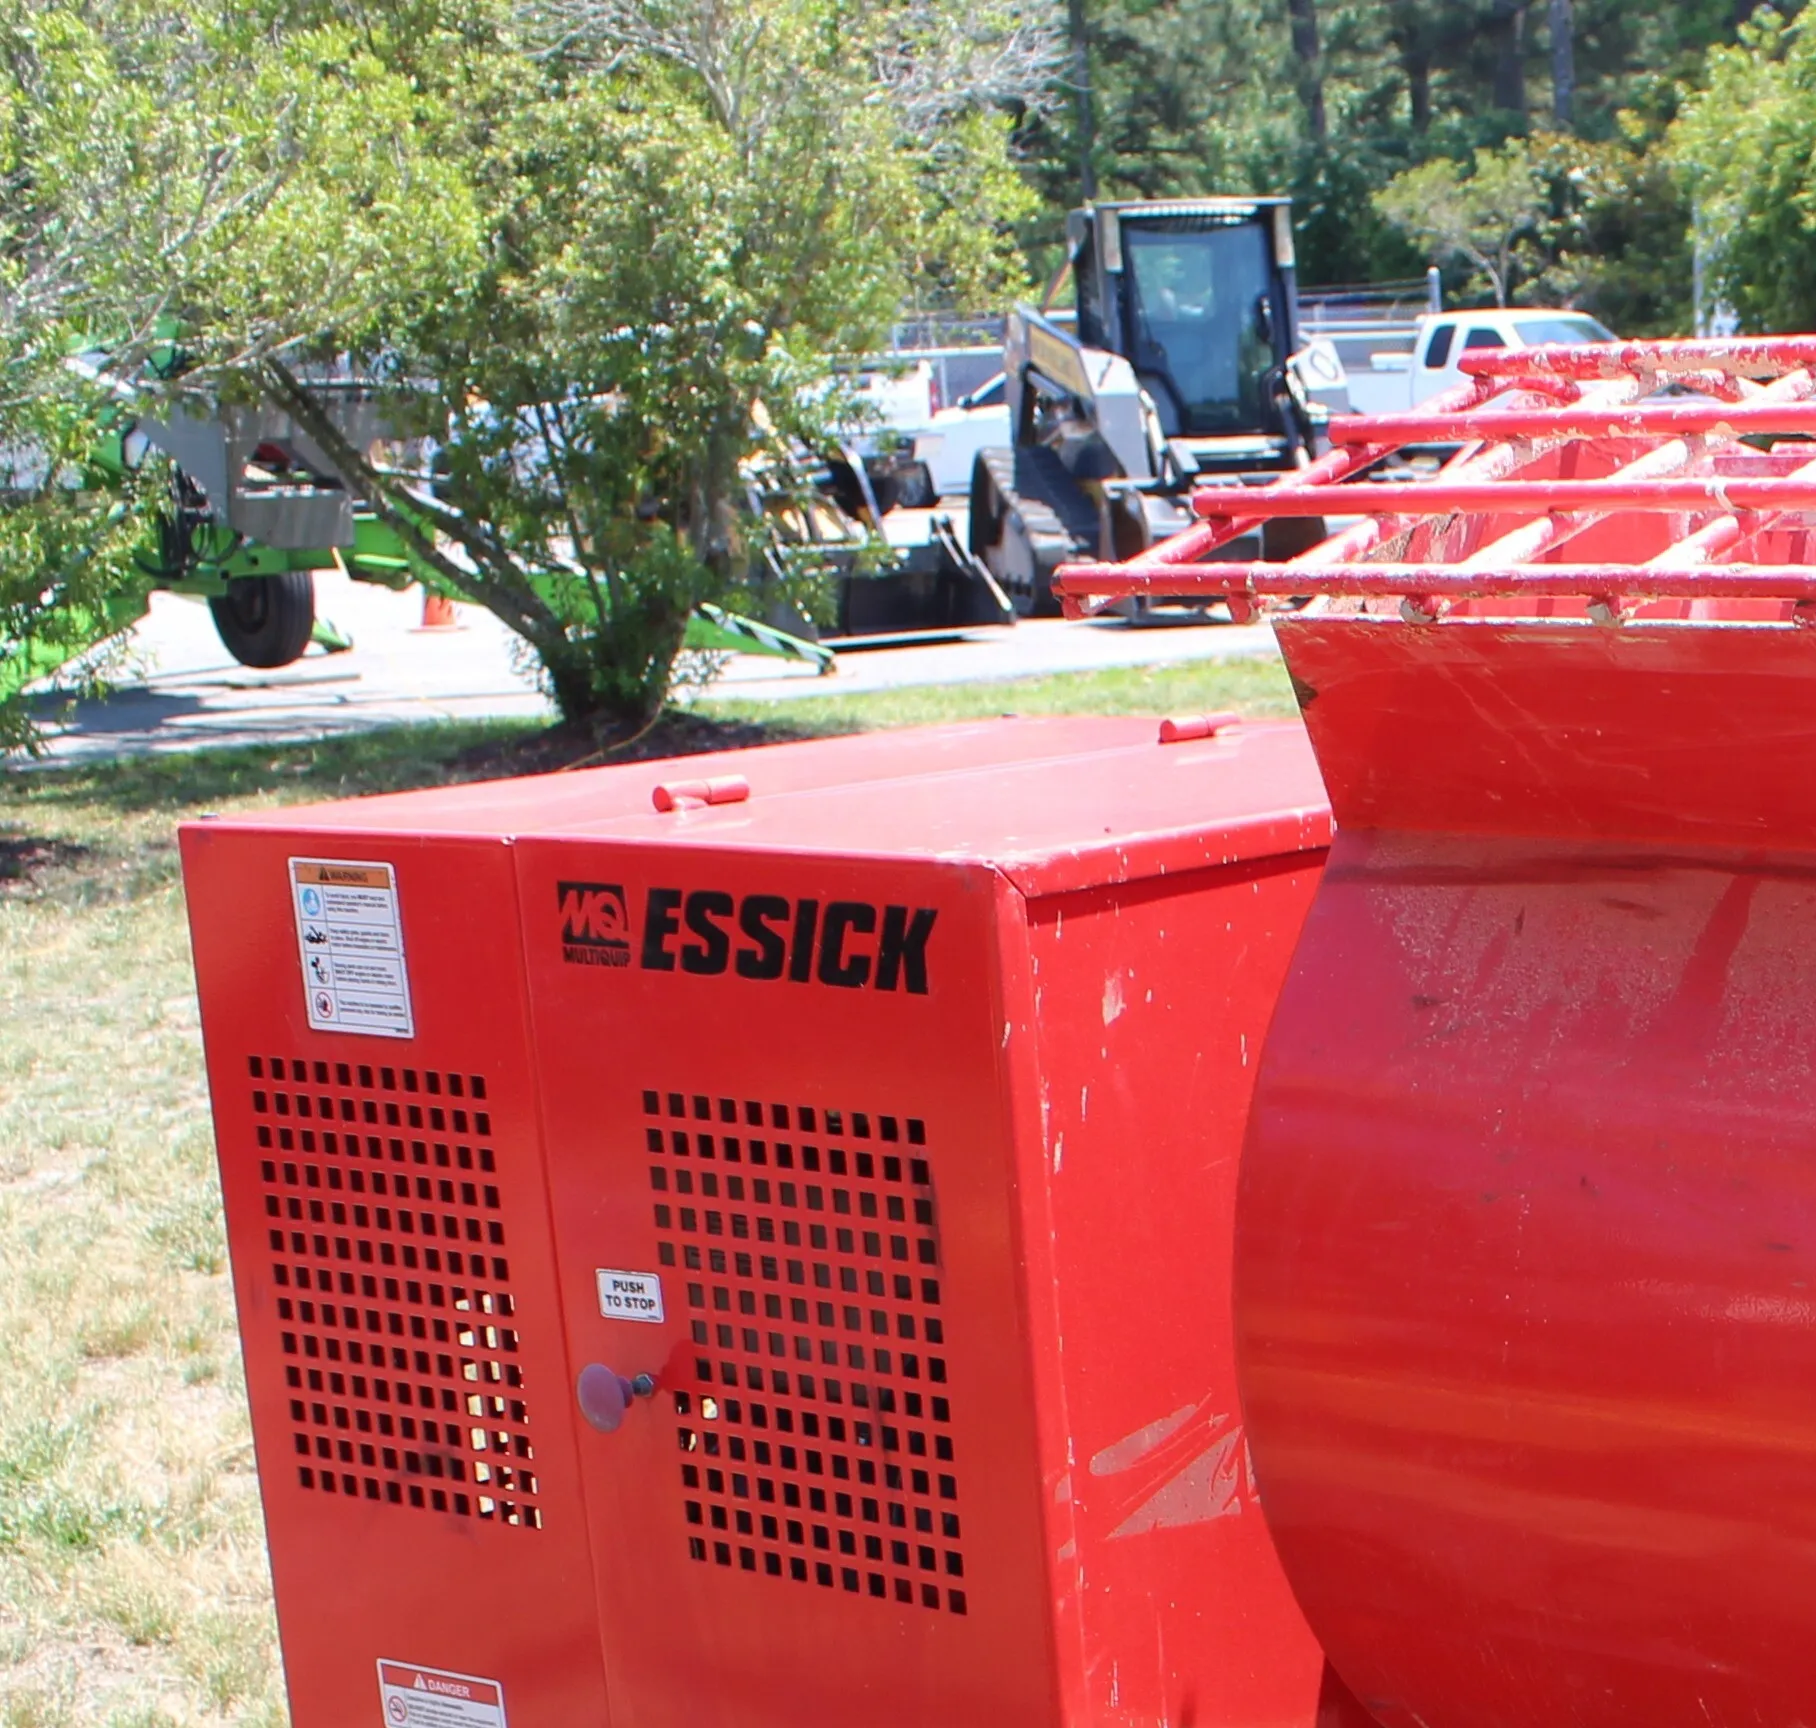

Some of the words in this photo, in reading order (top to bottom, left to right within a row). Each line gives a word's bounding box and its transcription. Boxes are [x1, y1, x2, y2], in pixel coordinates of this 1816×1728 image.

[641, 887, 938, 995] ESSICK
[562, 946, 631, 967] MULTIQUIP
[612, 1280, 645, 1294] PUSH
[605, 1295, 622, 1307] TO
[624, 1297, 656, 1310] STOP
[427, 1679, 470, 1698] DANGER
